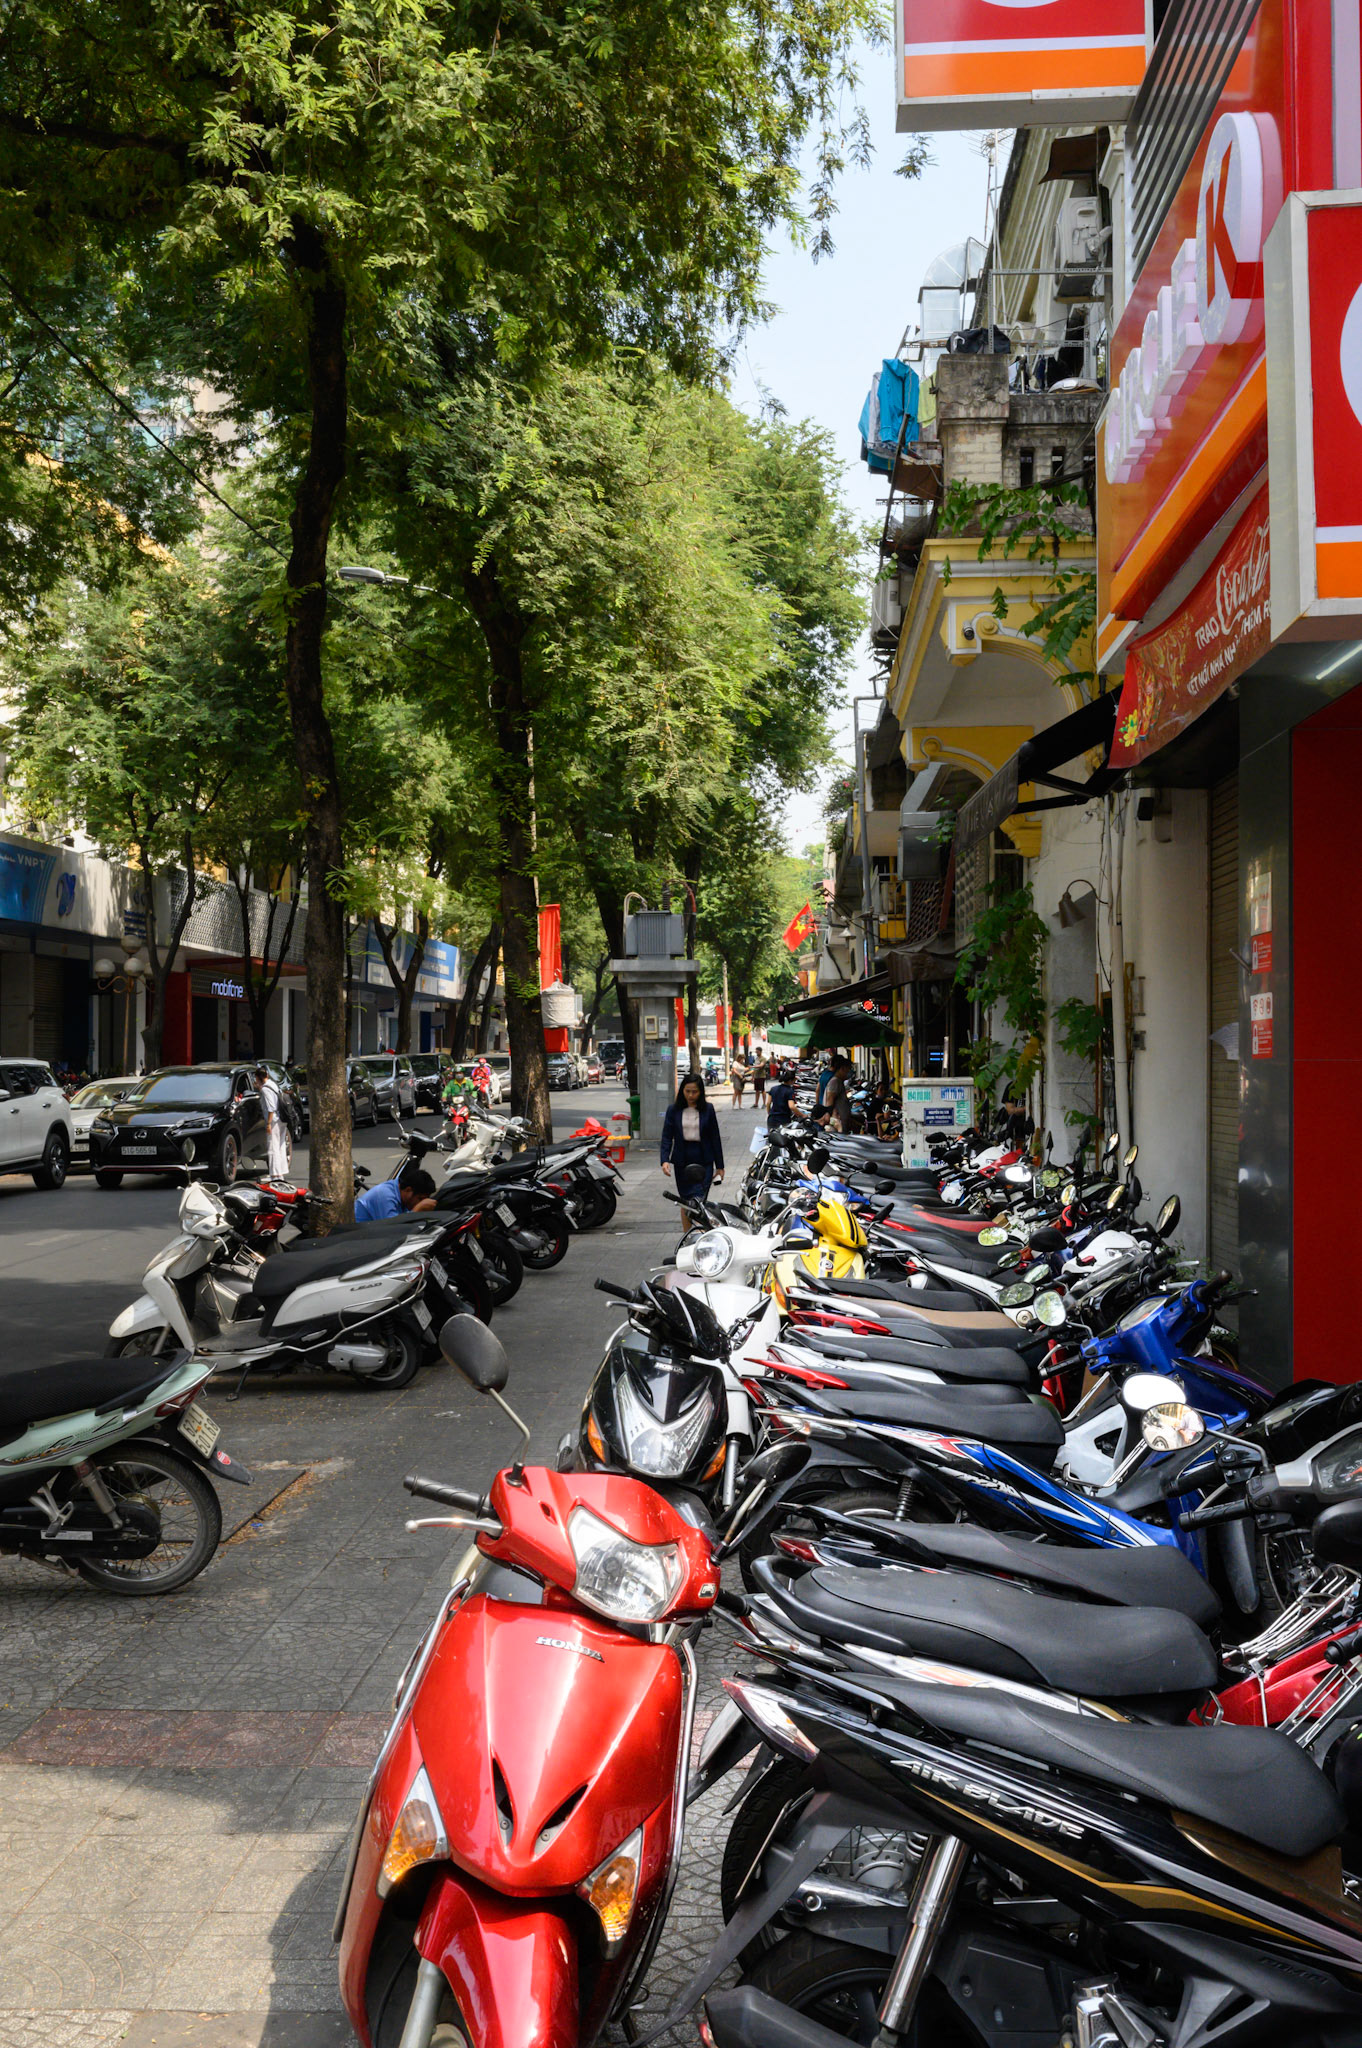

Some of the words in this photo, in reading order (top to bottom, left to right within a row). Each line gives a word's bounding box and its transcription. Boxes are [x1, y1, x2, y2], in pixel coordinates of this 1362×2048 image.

[1195, 616, 1219, 650] TRAO
[17, 853, 46, 870] VNPT
[211, 979, 244, 998] mobifone
[350, 1282, 383, 1292] LEAD
[654, 1361, 685, 1374] HONDA
[536, 1636, 604, 1662] HONDA
[890, 1759, 960, 1791] AIR
[962, 1783, 1085, 1840] BLADE
